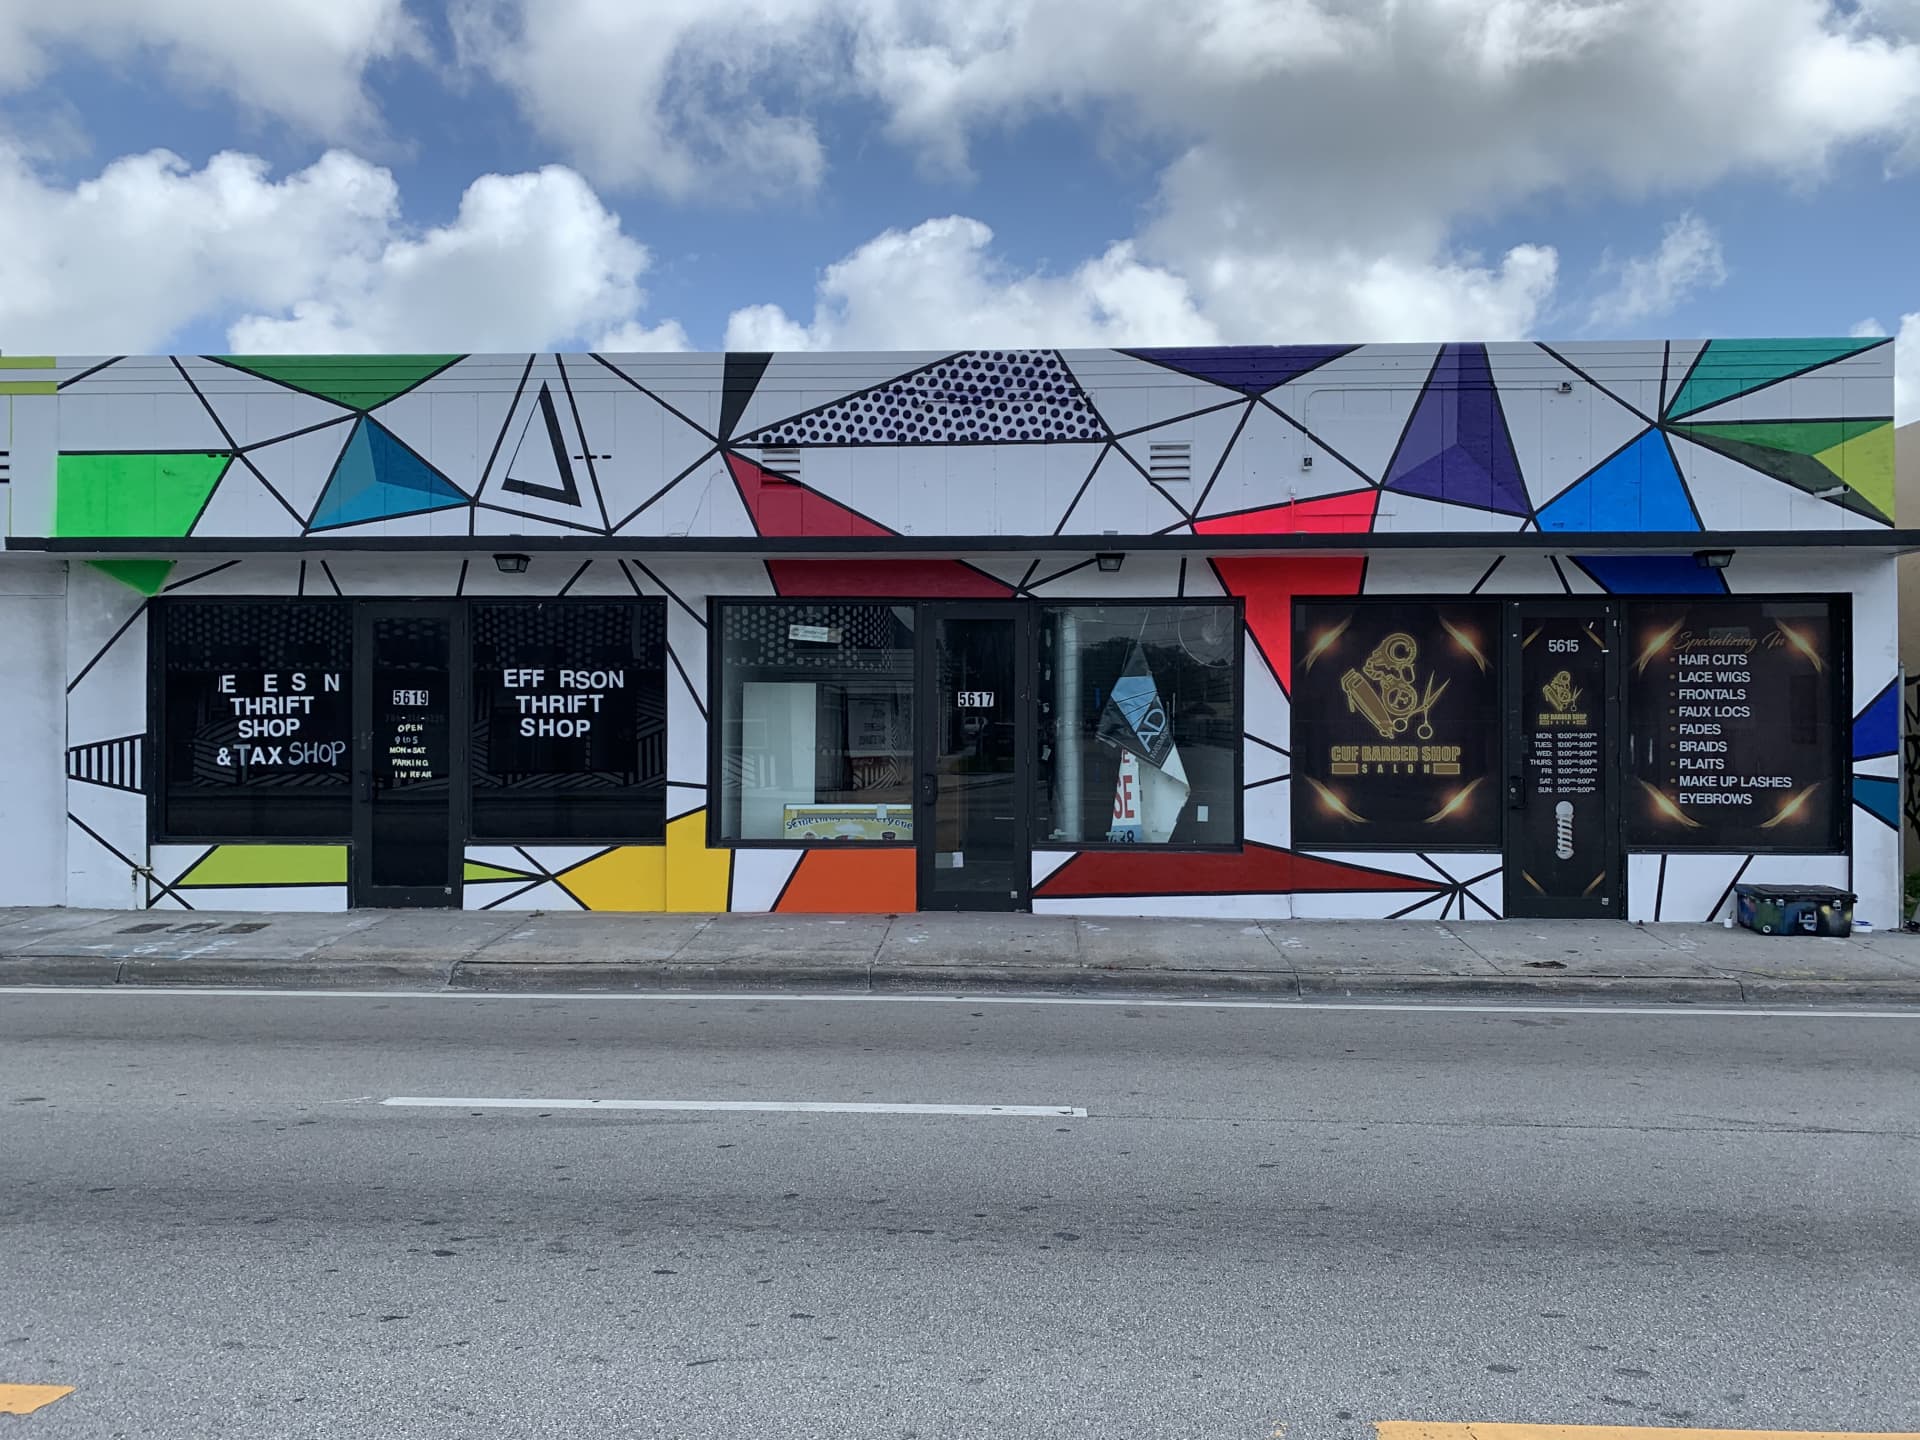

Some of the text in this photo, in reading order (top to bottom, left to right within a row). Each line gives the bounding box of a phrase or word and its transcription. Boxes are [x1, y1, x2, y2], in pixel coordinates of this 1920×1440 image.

[1549, 640, 1579, 652] 5615
[1674, 631, 1784, 653] Specializing In
[1679, 654, 1748, 666] HAIR CUTS
[1679, 672, 1750, 682] LACE WIGS
[394, 691, 428, 705] 5619
[959, 692, 993, 706] 5617
[1679, 689, 1746, 700] FRONTALS
[230, 696, 314, 715] THRIFT
[516, 694, 604, 714] THRIFT
[1679, 706, 1750, 717] FAUX LOCS
[239, 718, 300, 738] SHOP
[398, 724, 423, 732] OPEN
[520, 718, 590, 737] SHOP
[1680, 724, 1721, 735] FADES
[1680, 741, 1727, 752] BRAIDS
[217, 741, 346, 768] & TAX SHOP
[1331, 745, 1462, 762] CUF BARBER SHOP
[1680, 758, 1724, 769] PLAITS
[1680, 776, 1792, 788] MAKE UP LASHES
[1680, 793, 1752, 804] EYEBROWS
